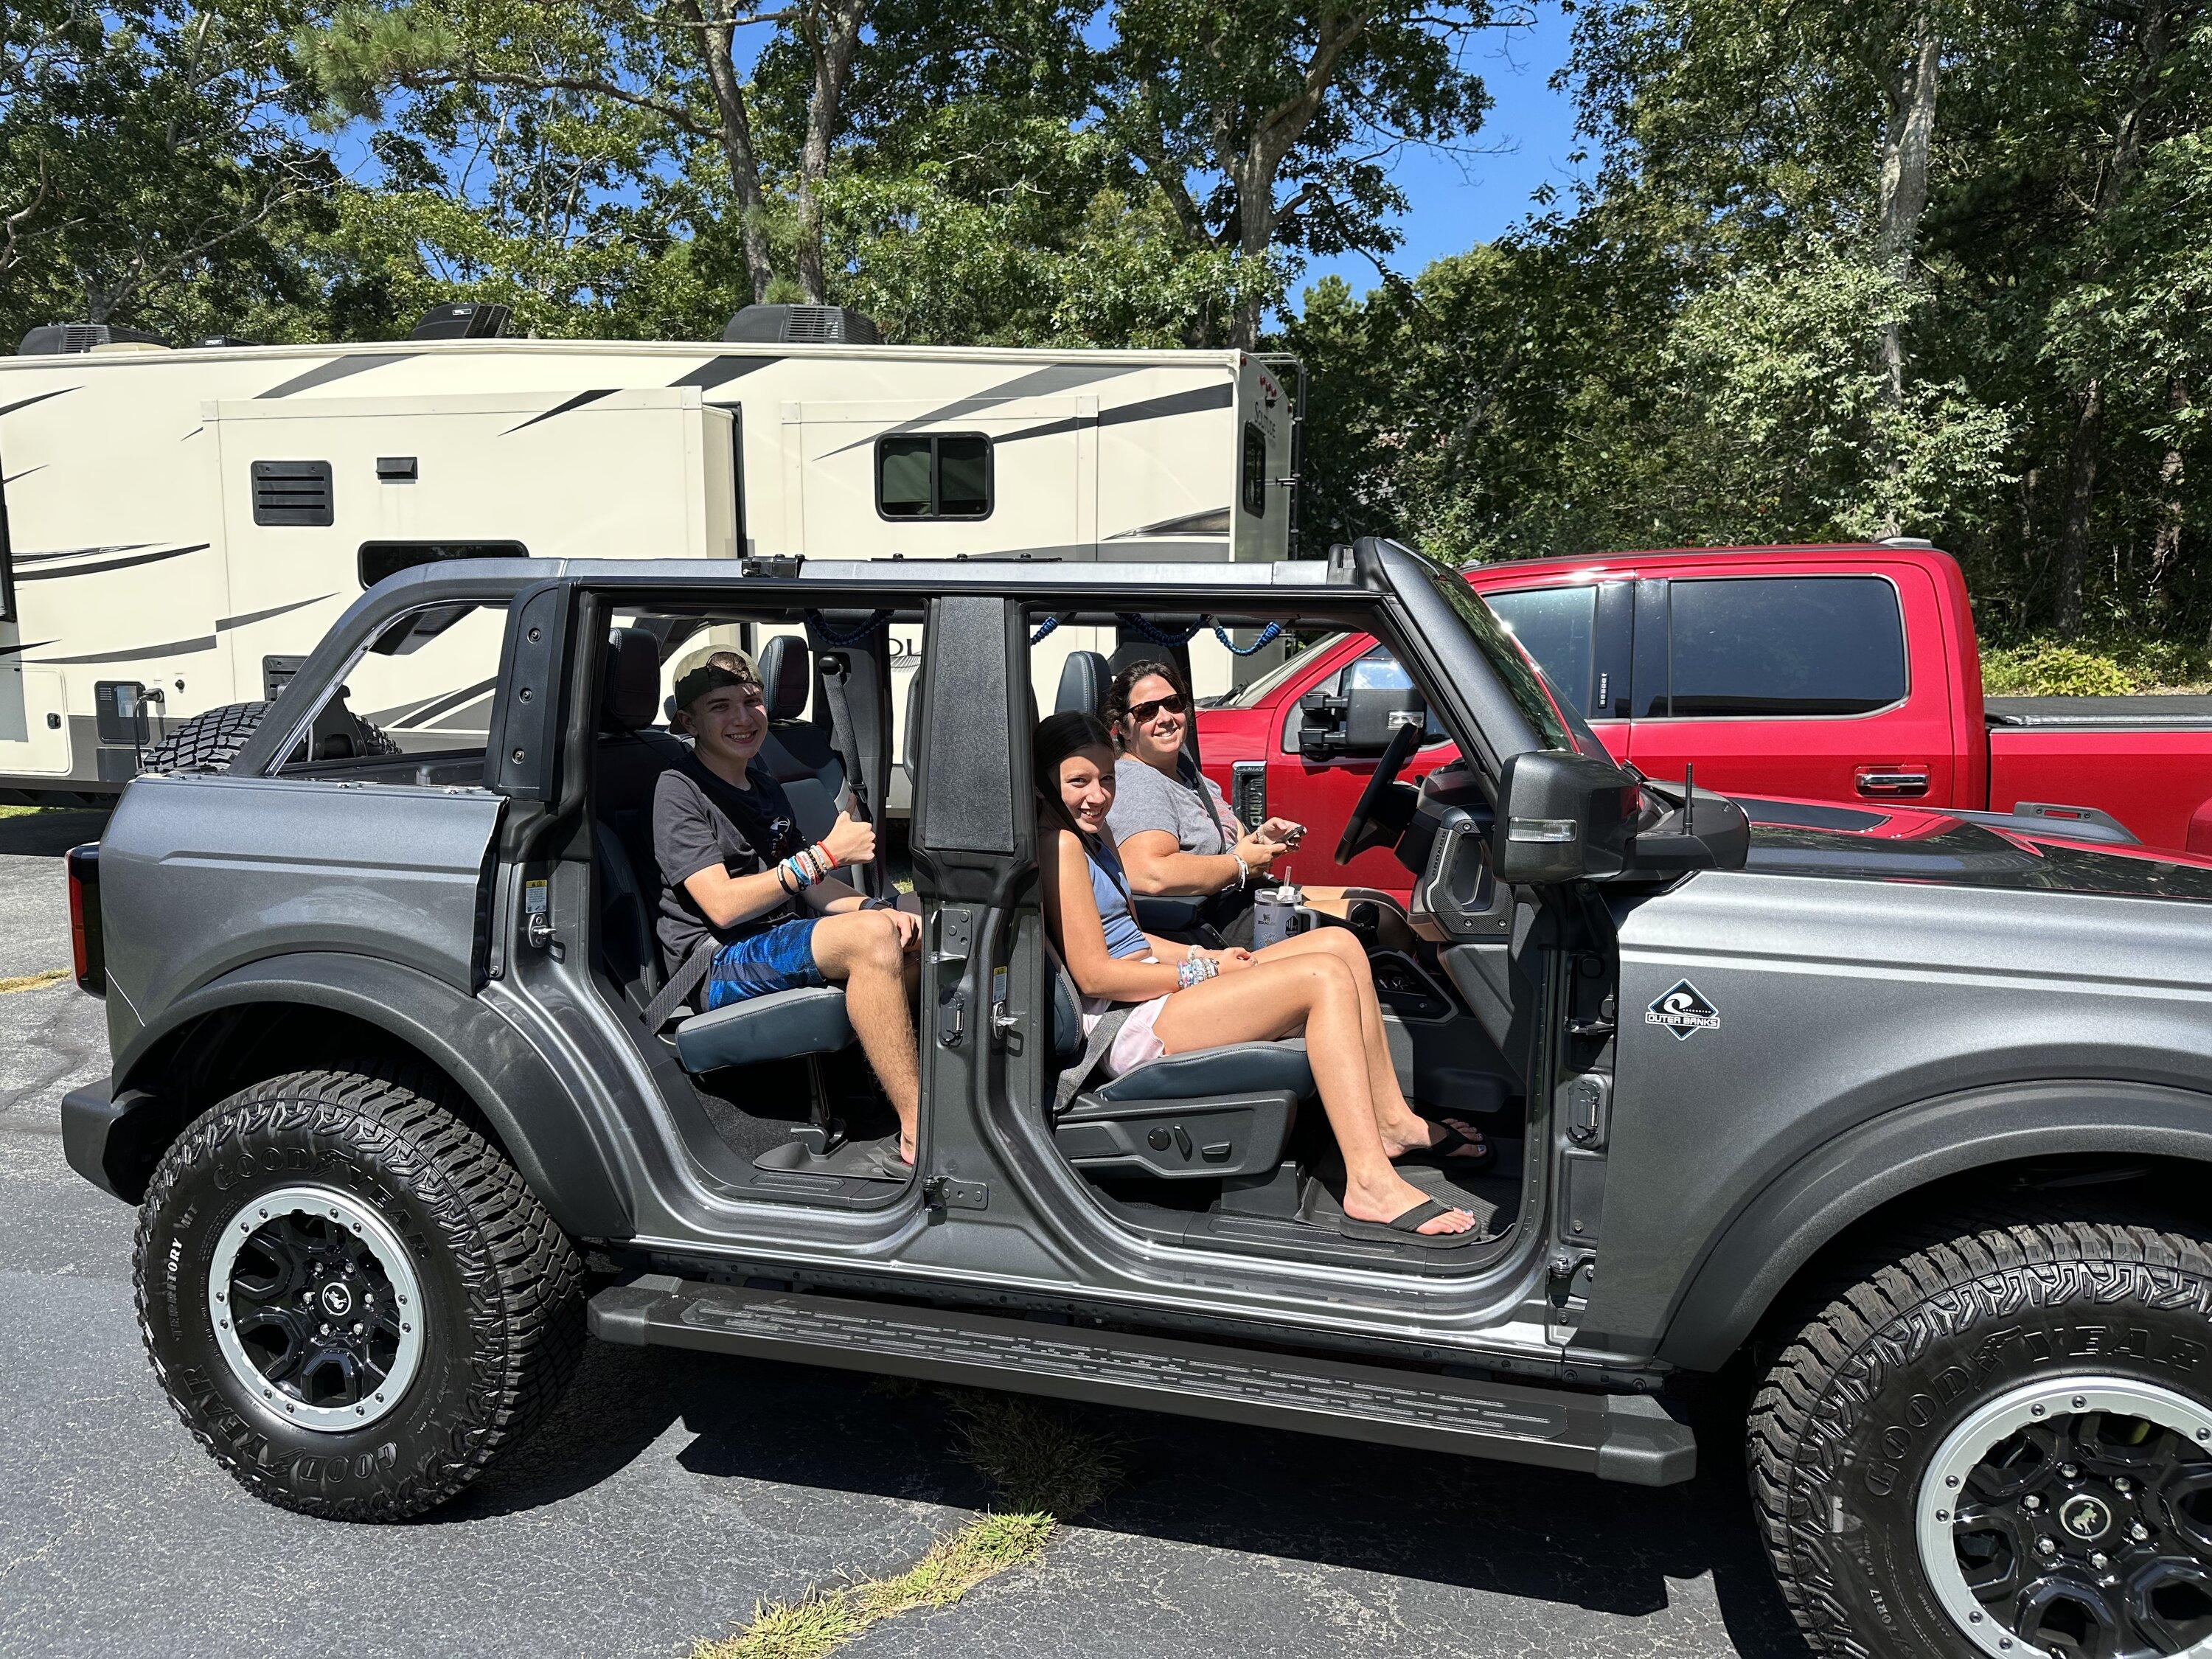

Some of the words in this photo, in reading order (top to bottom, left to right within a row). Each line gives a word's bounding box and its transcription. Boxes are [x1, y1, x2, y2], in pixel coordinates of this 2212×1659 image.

[1648, 1015, 1681, 1024] OUTER
[1683, 1017, 1717, 1026] BANKS
[213, 1147, 434, 1259] GOODYEAR
[166, 1237, 183, 1341] TERRITORY
[183, 1364, 399, 1483] GOODYEAR
[1864, 1325, 2208, 1496] GOODYEAR
